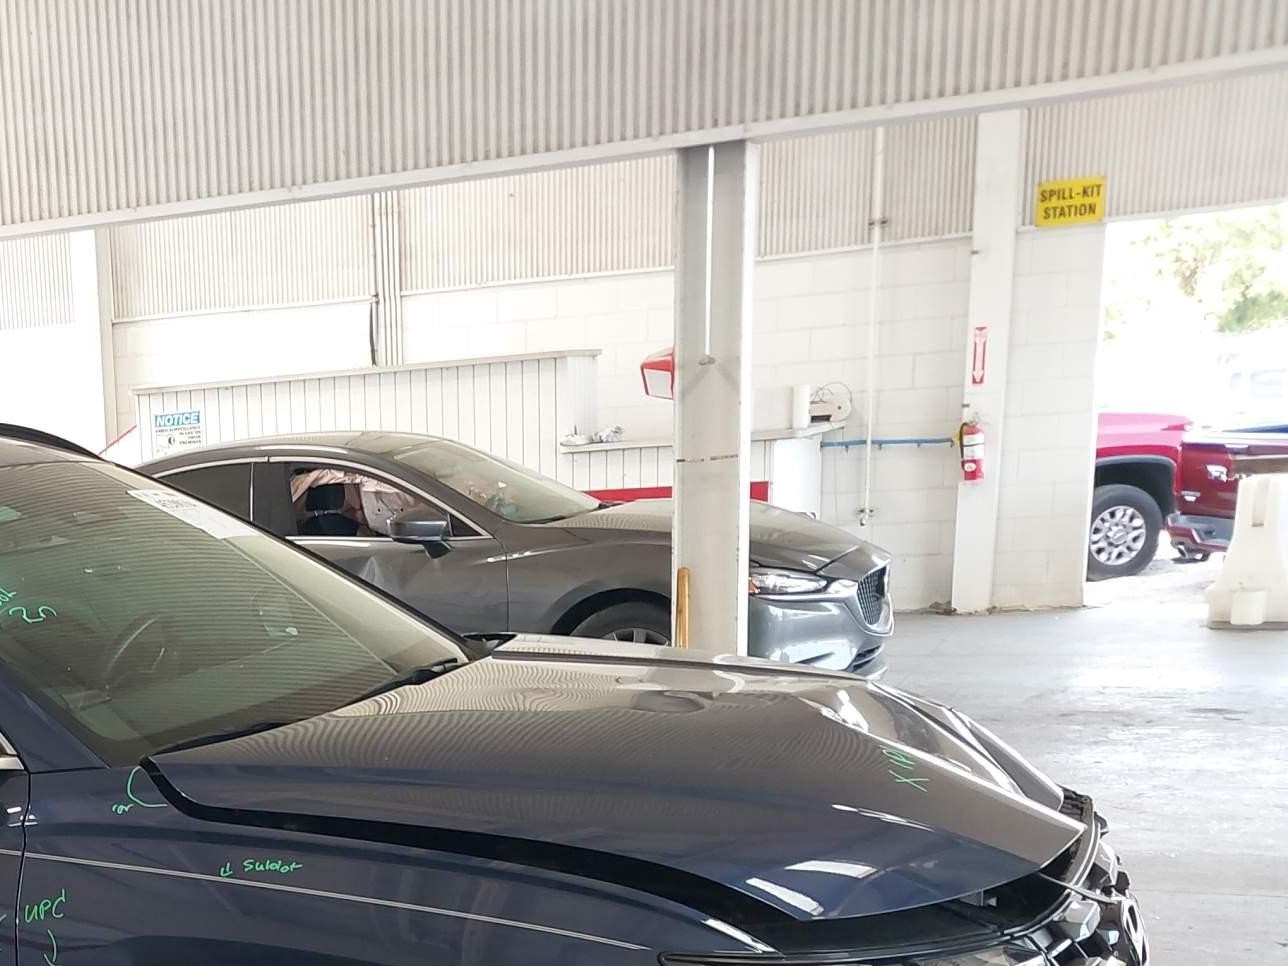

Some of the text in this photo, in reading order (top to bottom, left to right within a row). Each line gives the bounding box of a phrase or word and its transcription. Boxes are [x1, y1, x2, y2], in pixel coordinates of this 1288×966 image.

[1039, 184, 1102, 203] SPILL-KIT
[1043, 203, 1097, 220] STATION
[156, 412, 198, 427] NOTICE
